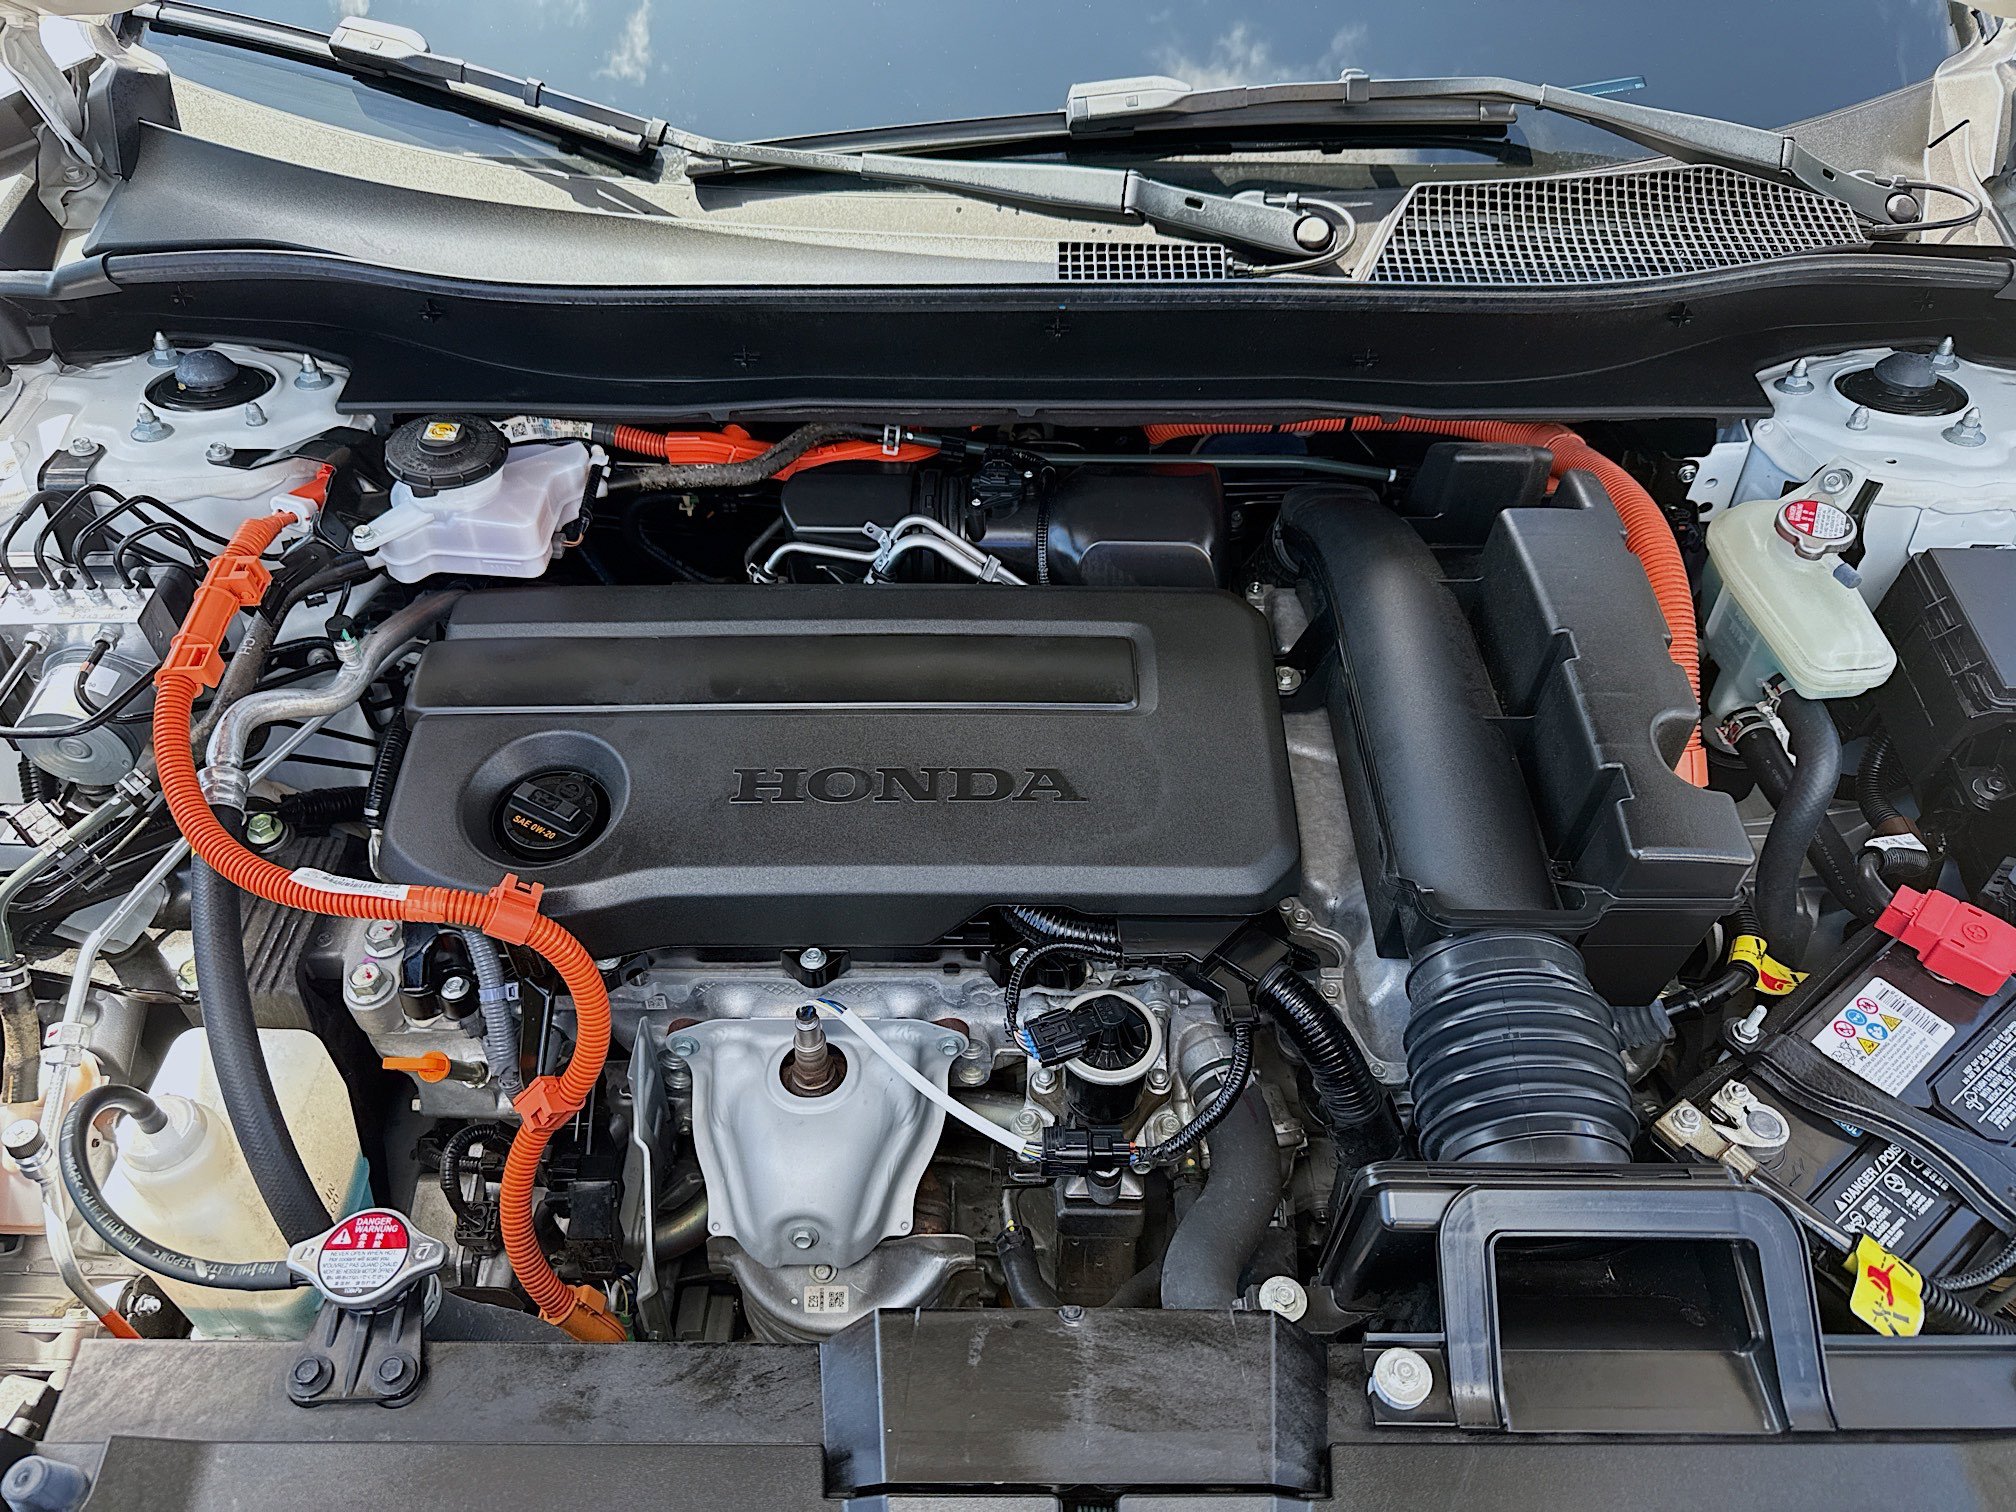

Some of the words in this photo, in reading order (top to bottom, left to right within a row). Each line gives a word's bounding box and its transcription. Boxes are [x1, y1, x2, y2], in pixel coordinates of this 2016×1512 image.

[728, 765, 1089, 806] HONDA
[512, 814, 533, 828] SAE
[530, 823, 556, 840] 0W-20
[1841, 1165, 1879, 1204] DANGER
[1867, 1202, 1883, 1218] EYES
[355, 1225, 398, 1233] WARNUNG
[356, 1217, 392, 1225] DANGER
